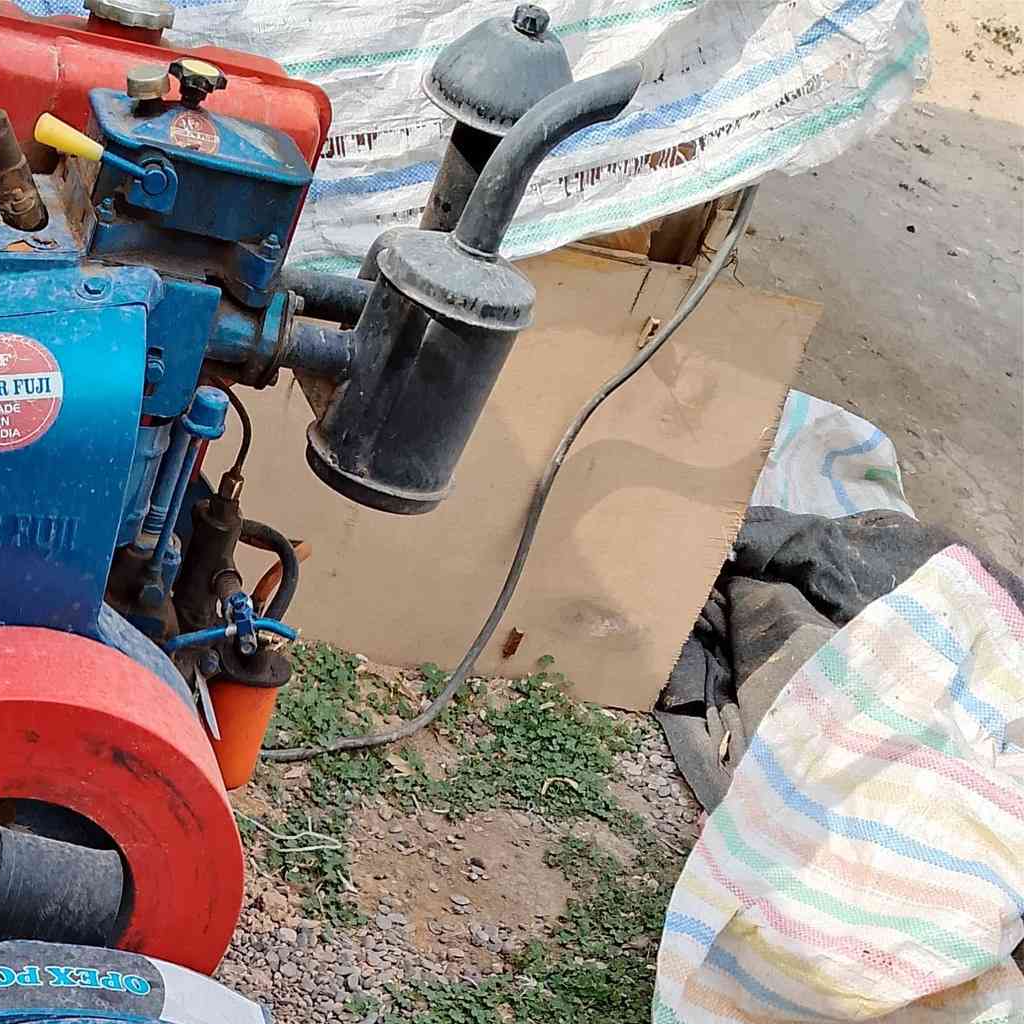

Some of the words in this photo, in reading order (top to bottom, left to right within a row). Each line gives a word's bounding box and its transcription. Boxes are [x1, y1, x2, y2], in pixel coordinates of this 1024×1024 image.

[13, 377, 52, 395] FUJI
[14, 512, 81, 556] FUJI
[46, 966, 152, 996] OPEX
